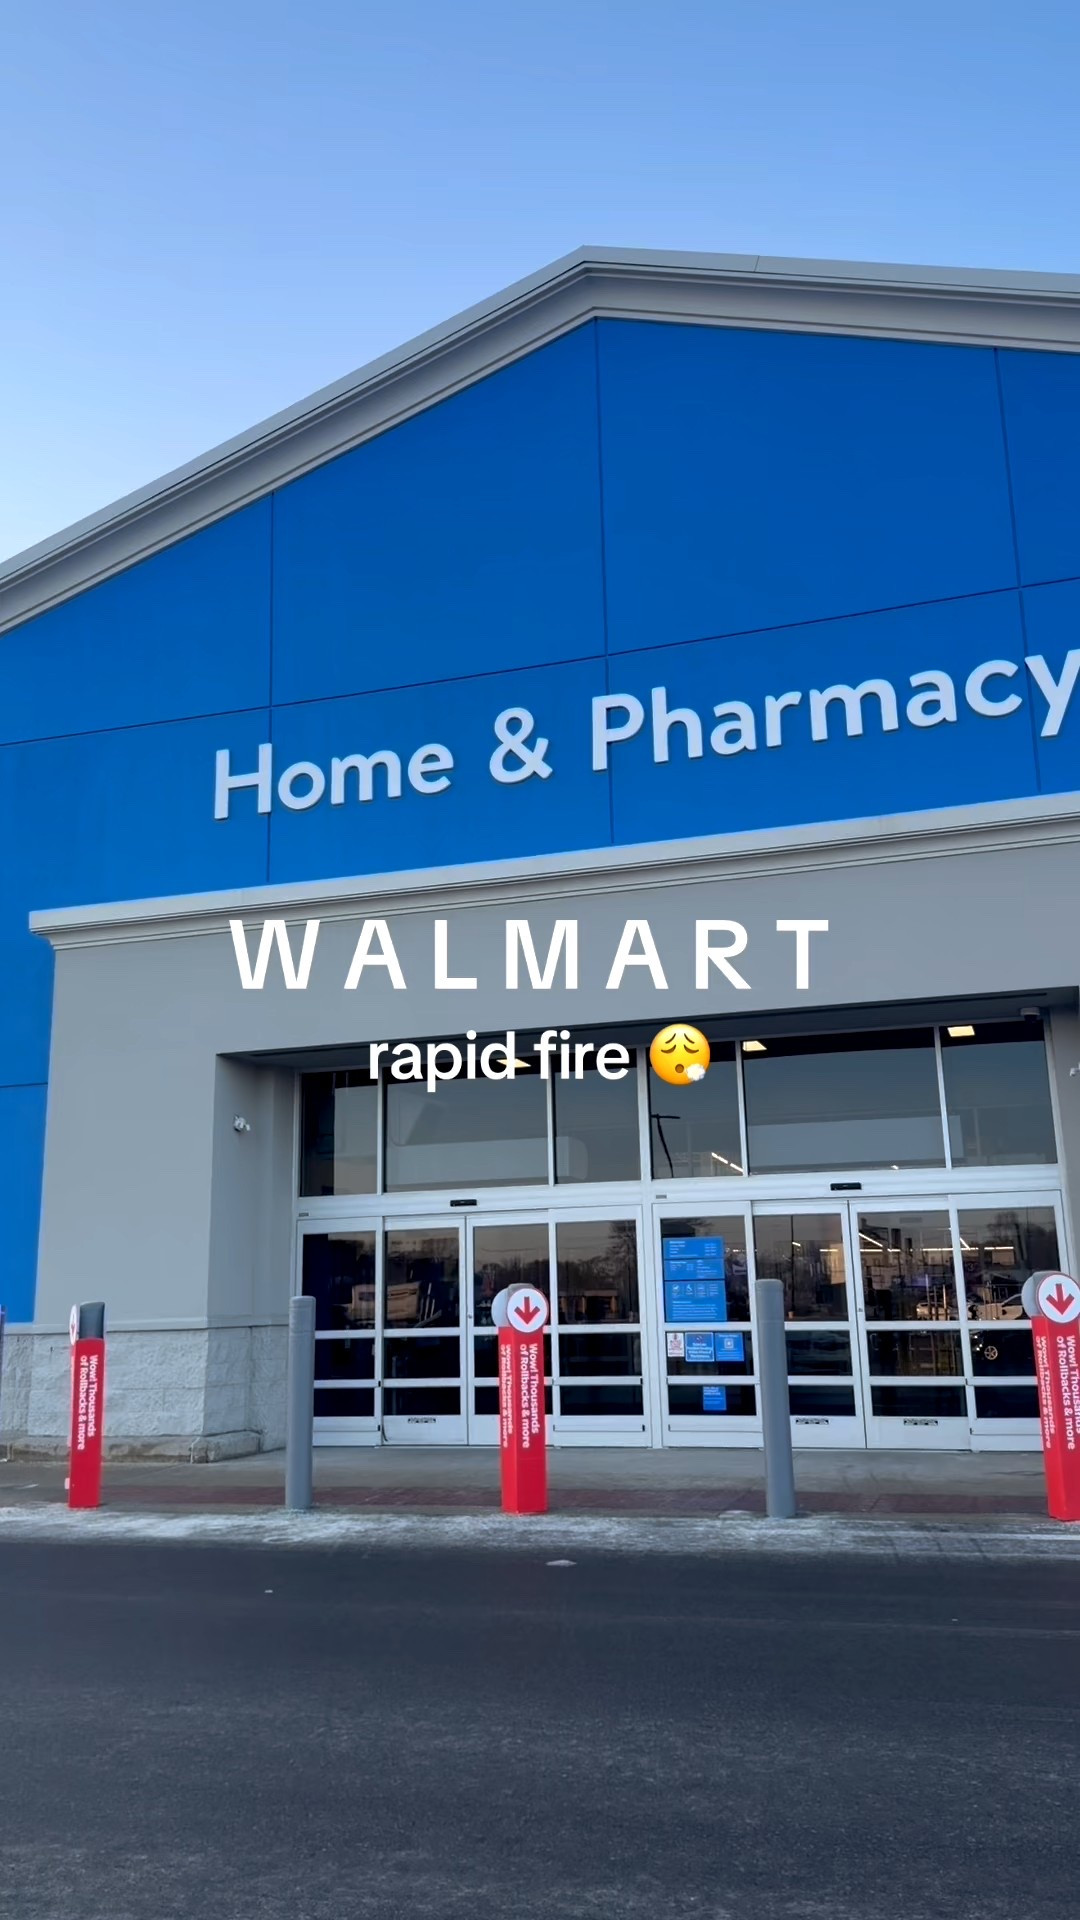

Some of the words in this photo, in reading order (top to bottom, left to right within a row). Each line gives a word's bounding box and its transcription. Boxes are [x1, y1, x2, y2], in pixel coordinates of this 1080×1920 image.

[214, 743, 454, 820] Home
[489, 707, 553, 783] &
[592, 648, 1080, 772] Pharmacy
[519, 1344, 529, 1356] of
[1056, 1336, 1066, 1348] of
[1066, 1335, 1077, 1367] Wow!
[80, 1355, 89, 1366] of
[89, 1354, 99, 1381] Wow!
[529, 1343, 539, 1372] Wow!
[78, 1367, 88, 1414] Rollbacks
[520, 1357, 530, 1408] Rollbacks
[1057, 1350, 1071, 1406] Rollbacks
[87, 1383, 98, 1437] Thousands
[521, 1409, 530, 1418] &
[530, 1374, 540, 1433] Thousands
[1063, 1407, 1073, 1416] &
[77, 1423, 86, 1451] more
[522, 1418, 530, 1448] more
[1065, 1417, 1076, 1450] more
